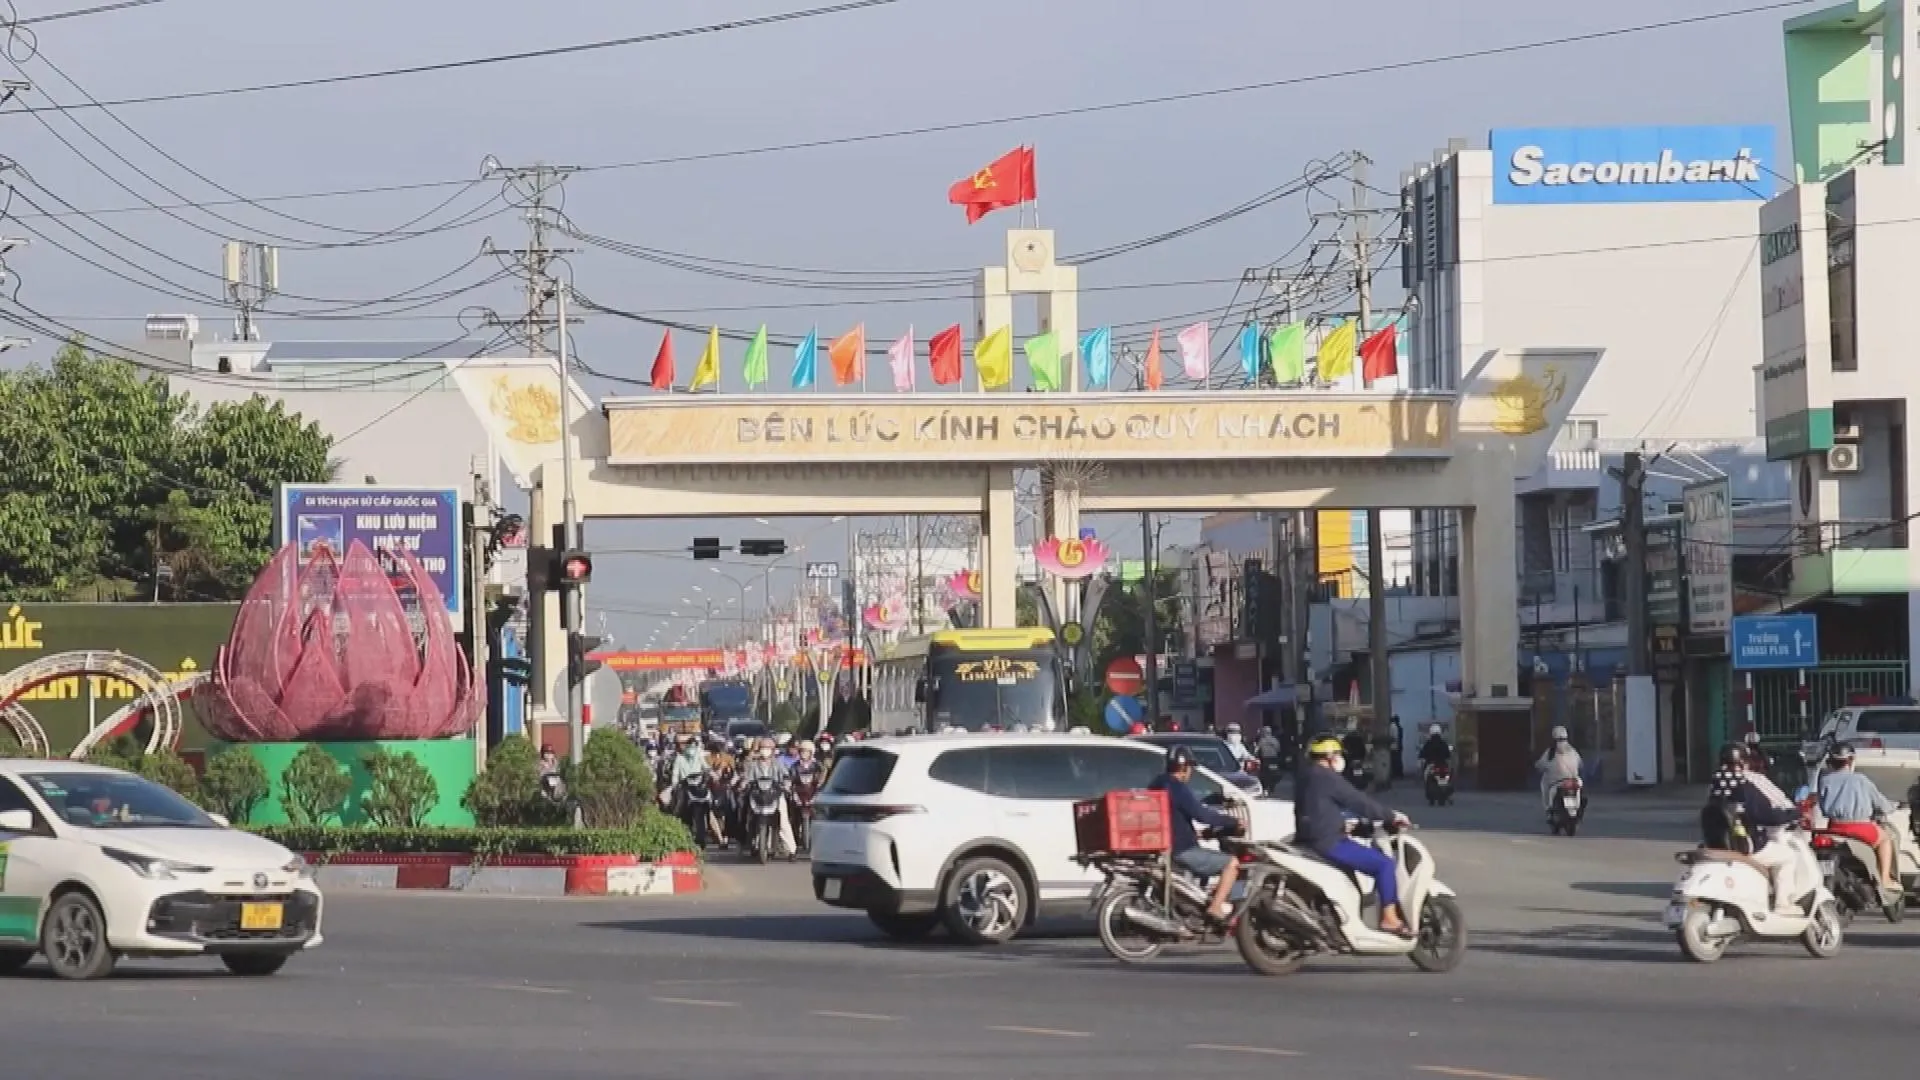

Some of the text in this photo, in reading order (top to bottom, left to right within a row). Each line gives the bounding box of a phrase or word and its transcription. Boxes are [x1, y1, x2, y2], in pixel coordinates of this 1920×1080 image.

[1509, 145, 1761, 186] Sacombank
[827, 410, 900, 442] LỨC
[914, 409, 999, 441] KÍNH
[1013, 408, 1116, 441] CHÀO
[1125, 408, 1199, 439] QUÝ
[1217, 406, 1340, 439] KHÁCH
[356, 512, 437, 533] KHU LƯU NIỆM
[808, 563, 838, 577] ACB
